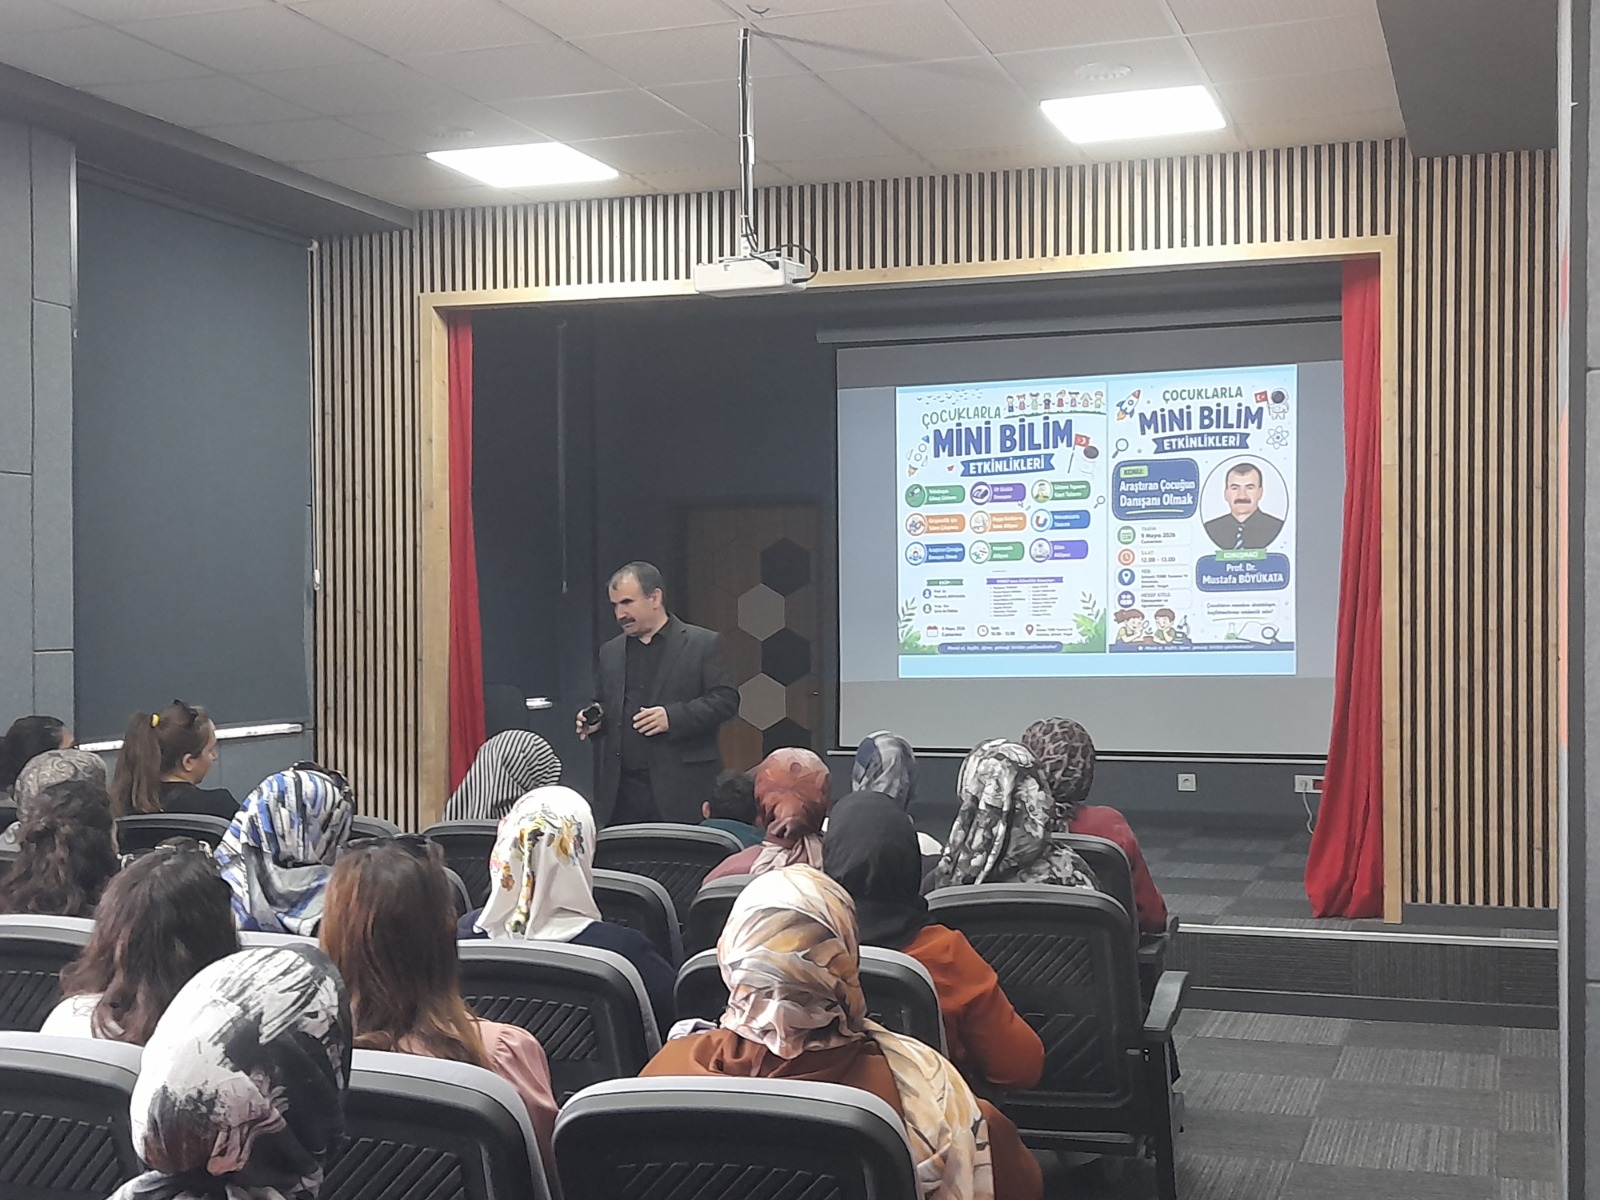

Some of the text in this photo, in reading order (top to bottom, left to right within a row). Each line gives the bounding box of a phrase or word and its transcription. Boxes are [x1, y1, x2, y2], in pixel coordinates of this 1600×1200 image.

[1163, 386, 1243, 404] ÇOCUKLARLA
[922, 405, 1001, 429] ÇOCUKLARLA
[1138, 402, 1264, 435] MİNİ BİLİM
[933, 416, 1073, 458] MİNİ BİLİM
[1163, 435, 1240, 451] ETKİNLİKLERİ
[969, 457, 1045, 475] ETKİNLİKLERİ
[1119, 479, 1196, 493] Araştıran Çocuğun
[1120, 492, 1193, 508] Danışanı Olmak
[1226, 562, 1257, 572] Prof. Dr.
[1202, 572, 1284, 584] Mustafa BÖYÜKATA
